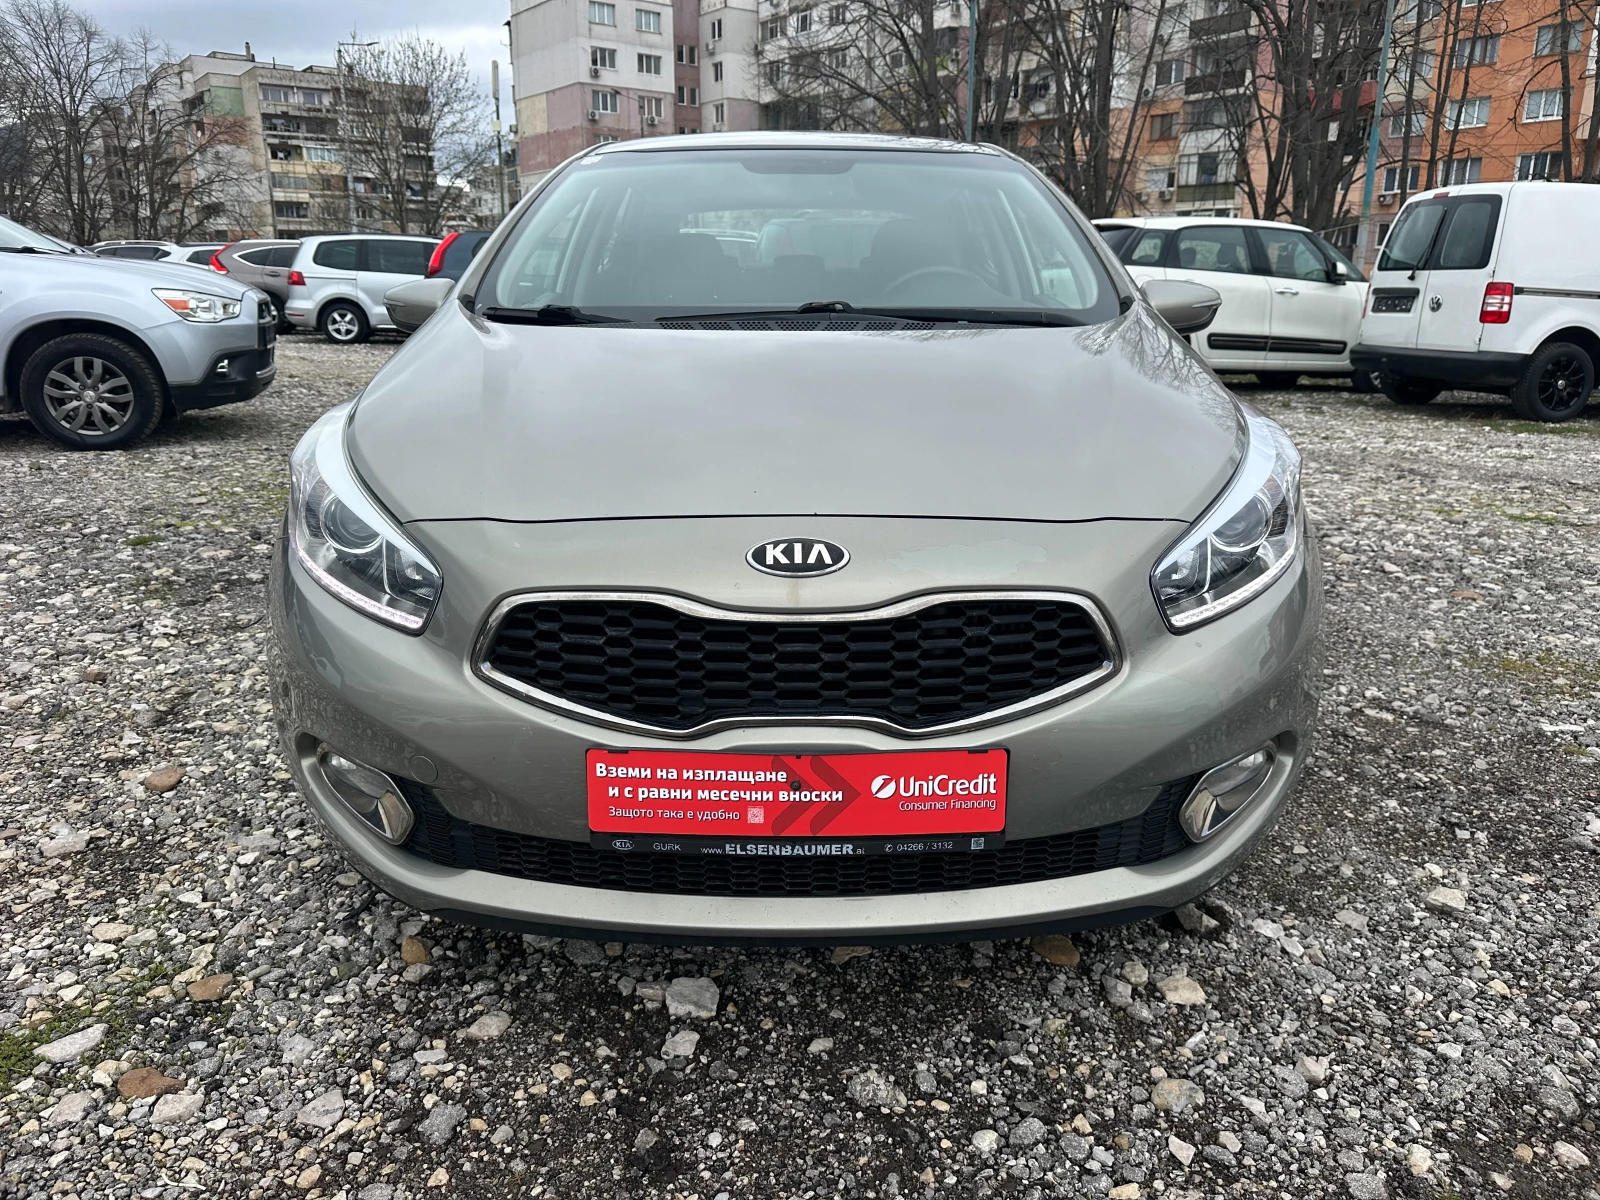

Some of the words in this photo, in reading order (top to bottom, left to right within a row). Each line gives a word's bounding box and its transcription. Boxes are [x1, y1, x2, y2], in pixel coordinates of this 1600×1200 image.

[764, 542, 833, 565] KIA
[595, 763, 651, 779] Вземи
[656, 767, 678, 780] на
[682, 768, 787, 785] изплащане
[899, 773, 997, 797] UniCredit
[608, 786, 619, 798] и
[624, 786, 633, 798] с
[638, 787, 692, 802] равни
[697, 789, 773, 802] месечни
[778, 789, 843, 802] вноски
[899, 800, 948, 811] Consumer
[950, 798, 996, 811] Financing
[608, 806, 654, 819] Защото
[656, 808, 684, 819] така
[687, 810, 694, 819] е
[696, 809, 740, 822] удобно
[653, 842, 682, 851] GURK
[700, 843, 865, 856] www.ELSENBAUMER.at
[896, 843, 924, 852] 04266
[931, 841, 953, 850] 3132
